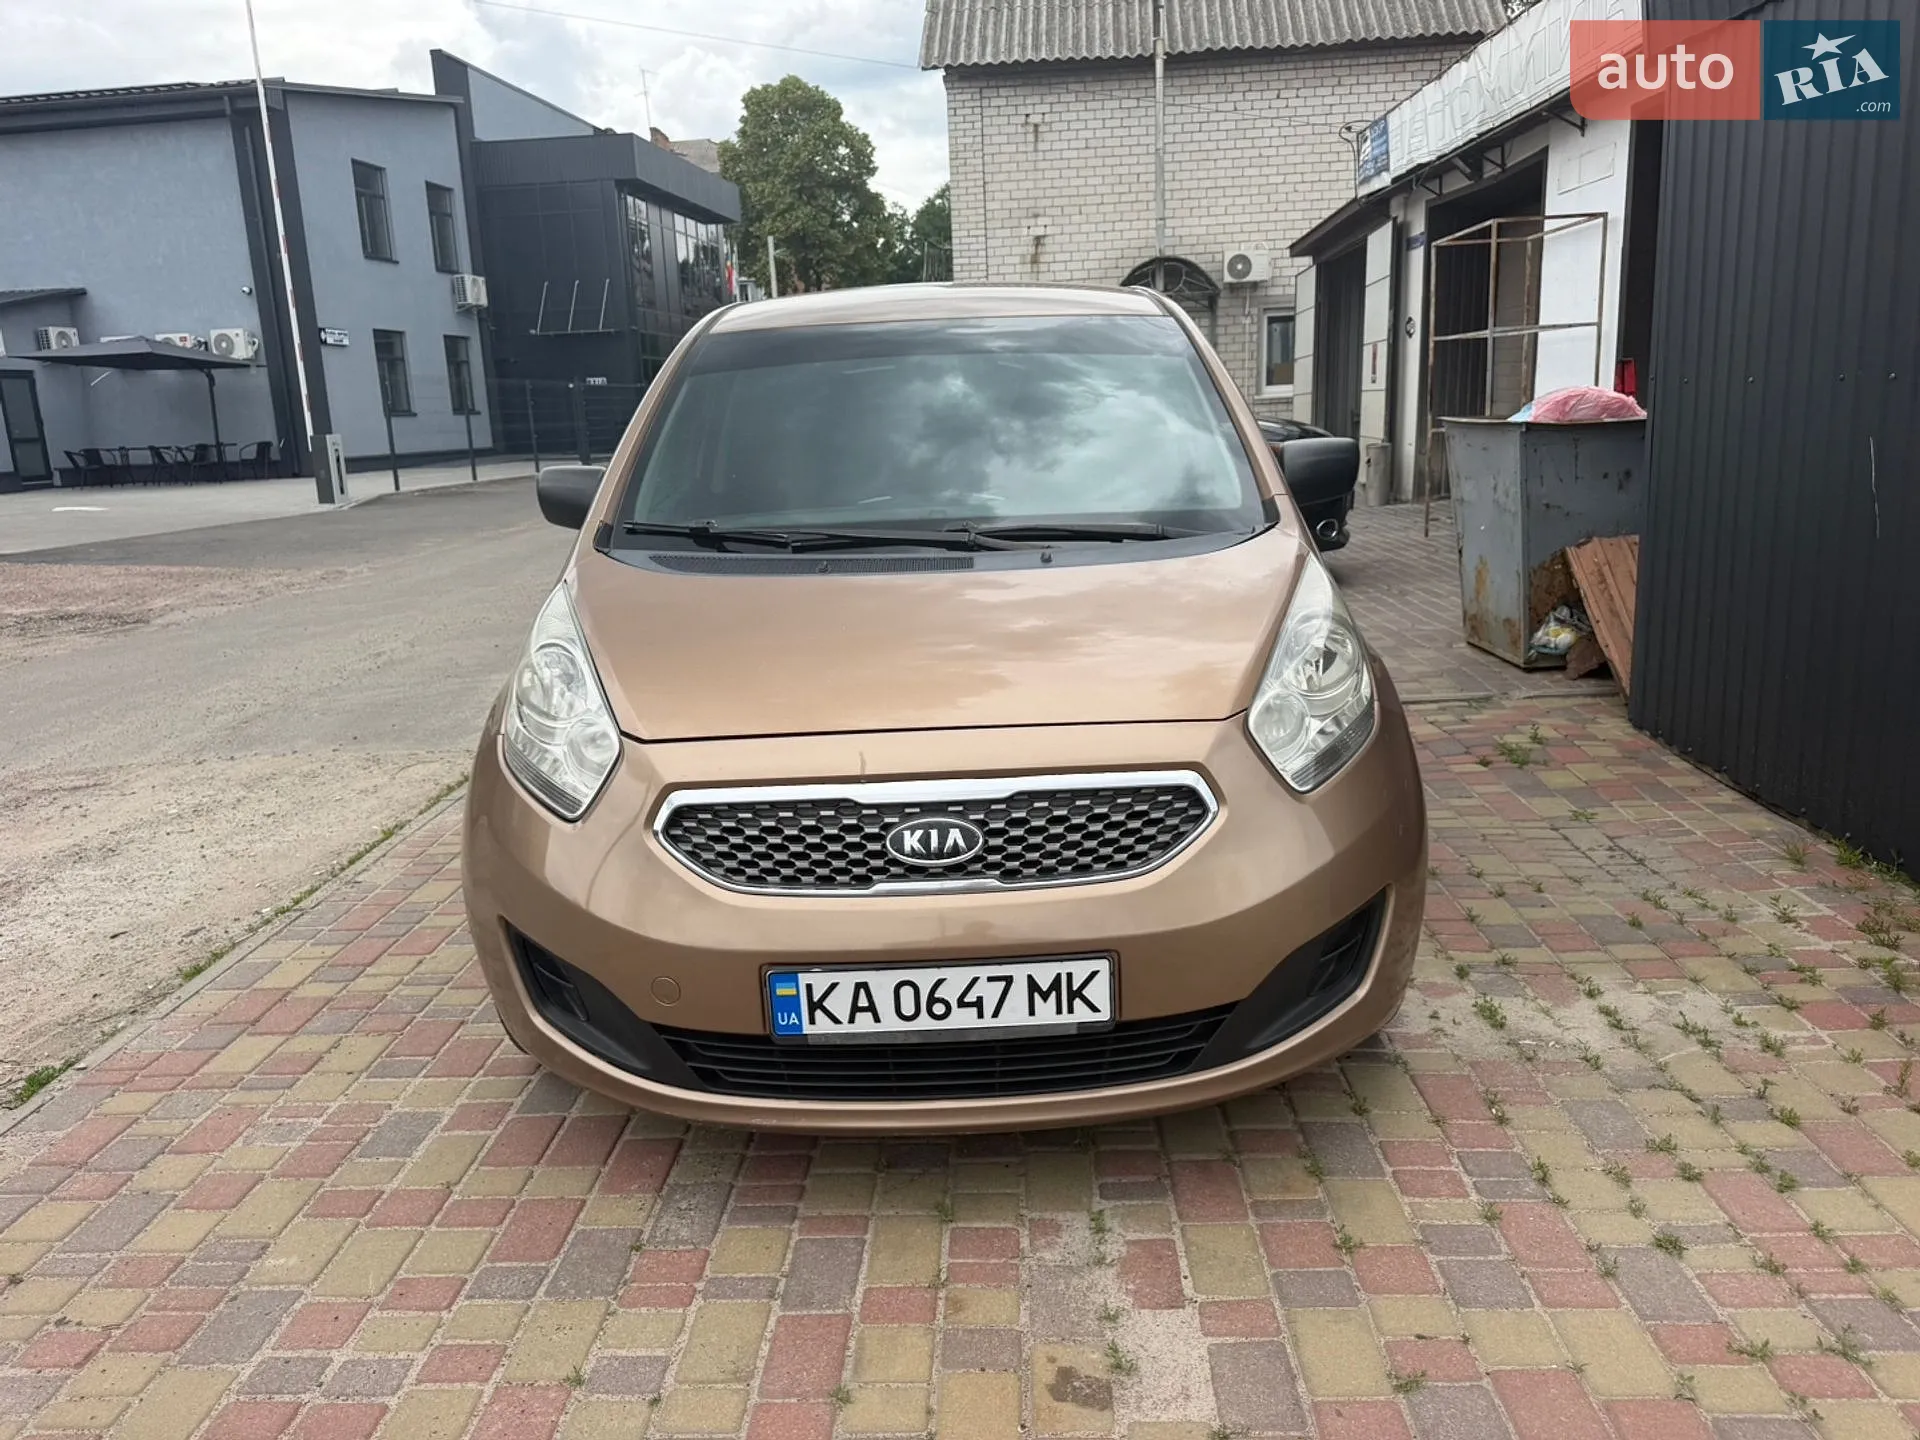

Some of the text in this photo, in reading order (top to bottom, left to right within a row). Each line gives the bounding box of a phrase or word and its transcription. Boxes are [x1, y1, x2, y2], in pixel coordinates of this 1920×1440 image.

[902, 829, 968, 854] KIA
[805, 969, 1102, 1025] KA 0647 MK
[777, 1013, 799, 1026] UA
